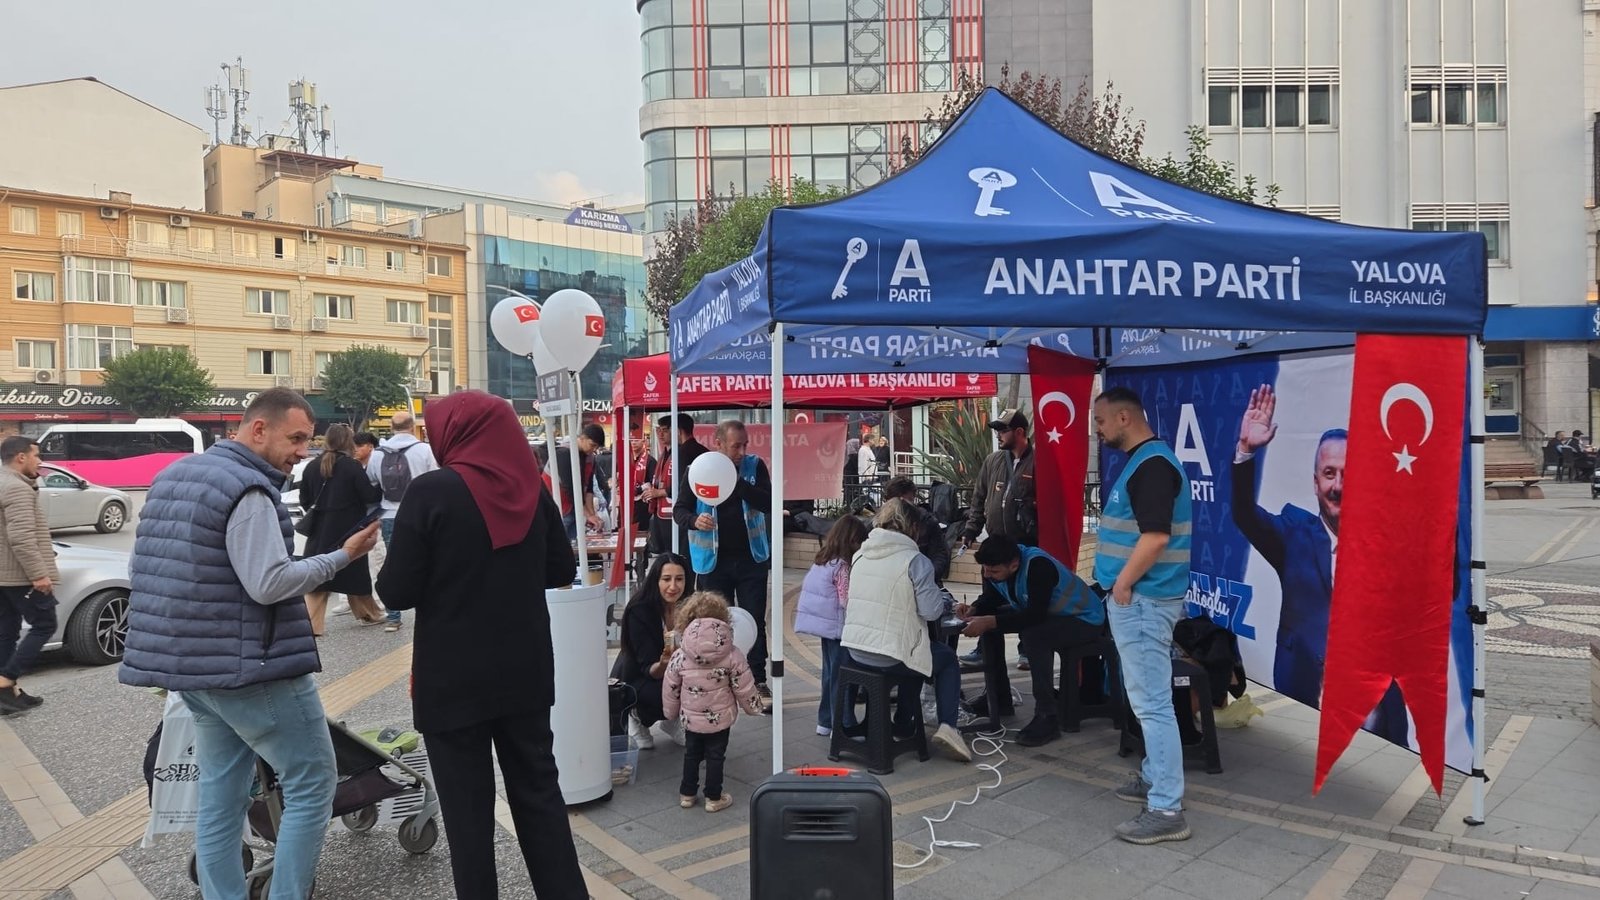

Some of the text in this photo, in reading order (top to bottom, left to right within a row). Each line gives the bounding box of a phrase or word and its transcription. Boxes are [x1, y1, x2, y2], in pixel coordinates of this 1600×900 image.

[1089, 171, 1192, 208] A
[730, 255, 762, 291] YALOVA
[889, 239, 931, 286] A
[984, 257, 1182, 297] ANAHTAR
[1351, 260, 1447, 285] YALOVA
[1349, 287, 1446, 307] İL BAŞKANLIĞI
[686, 301, 713, 348] ANAHTAR
[675, 376, 721, 393] ZAFER
[789, 374, 847, 389] YALOVA
[1174, 402, 1213, 477] A
